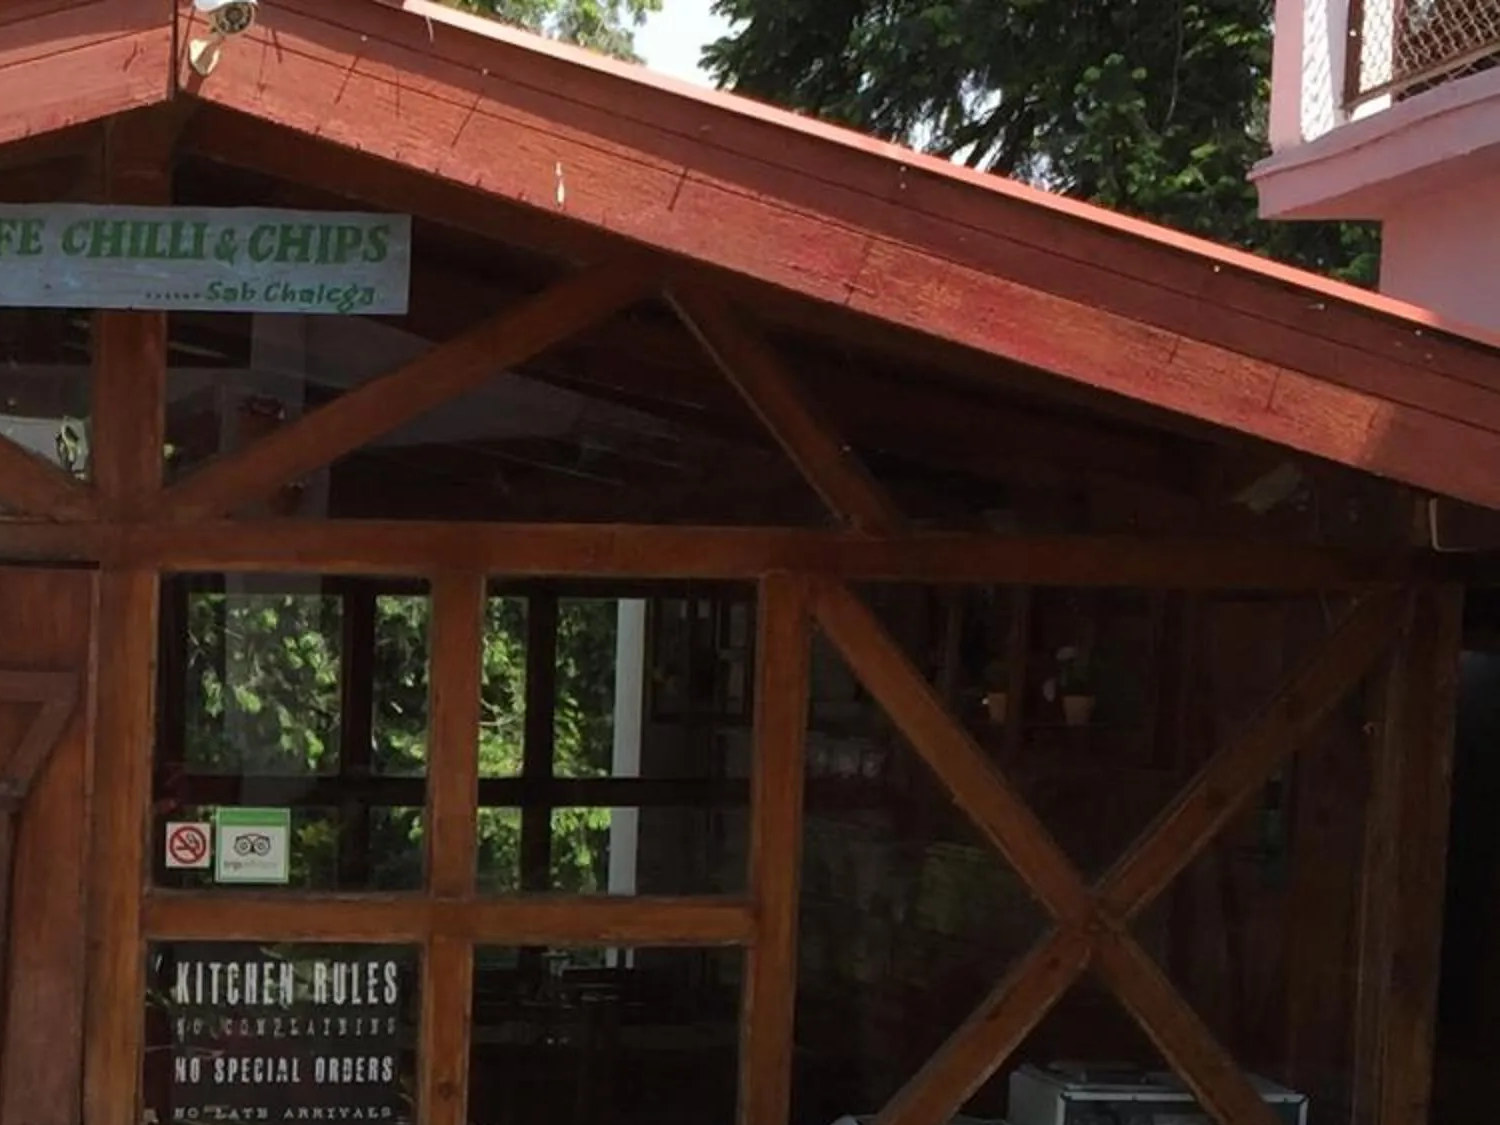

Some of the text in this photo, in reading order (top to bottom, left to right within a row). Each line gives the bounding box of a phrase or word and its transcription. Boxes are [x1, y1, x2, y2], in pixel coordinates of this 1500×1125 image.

[61, 218, 207, 261] CHILLI
[213, 228, 239, 263] &
[247, 222, 392, 265] CHIPS
[176, 961, 399, 1006] KITCHEN RULES
[174, 1056, 394, 1083] NO SPECIAL ORDERS
[174, 1107, 199, 1120] NO
[283, 1106, 392, 1119] ARRIVALS
